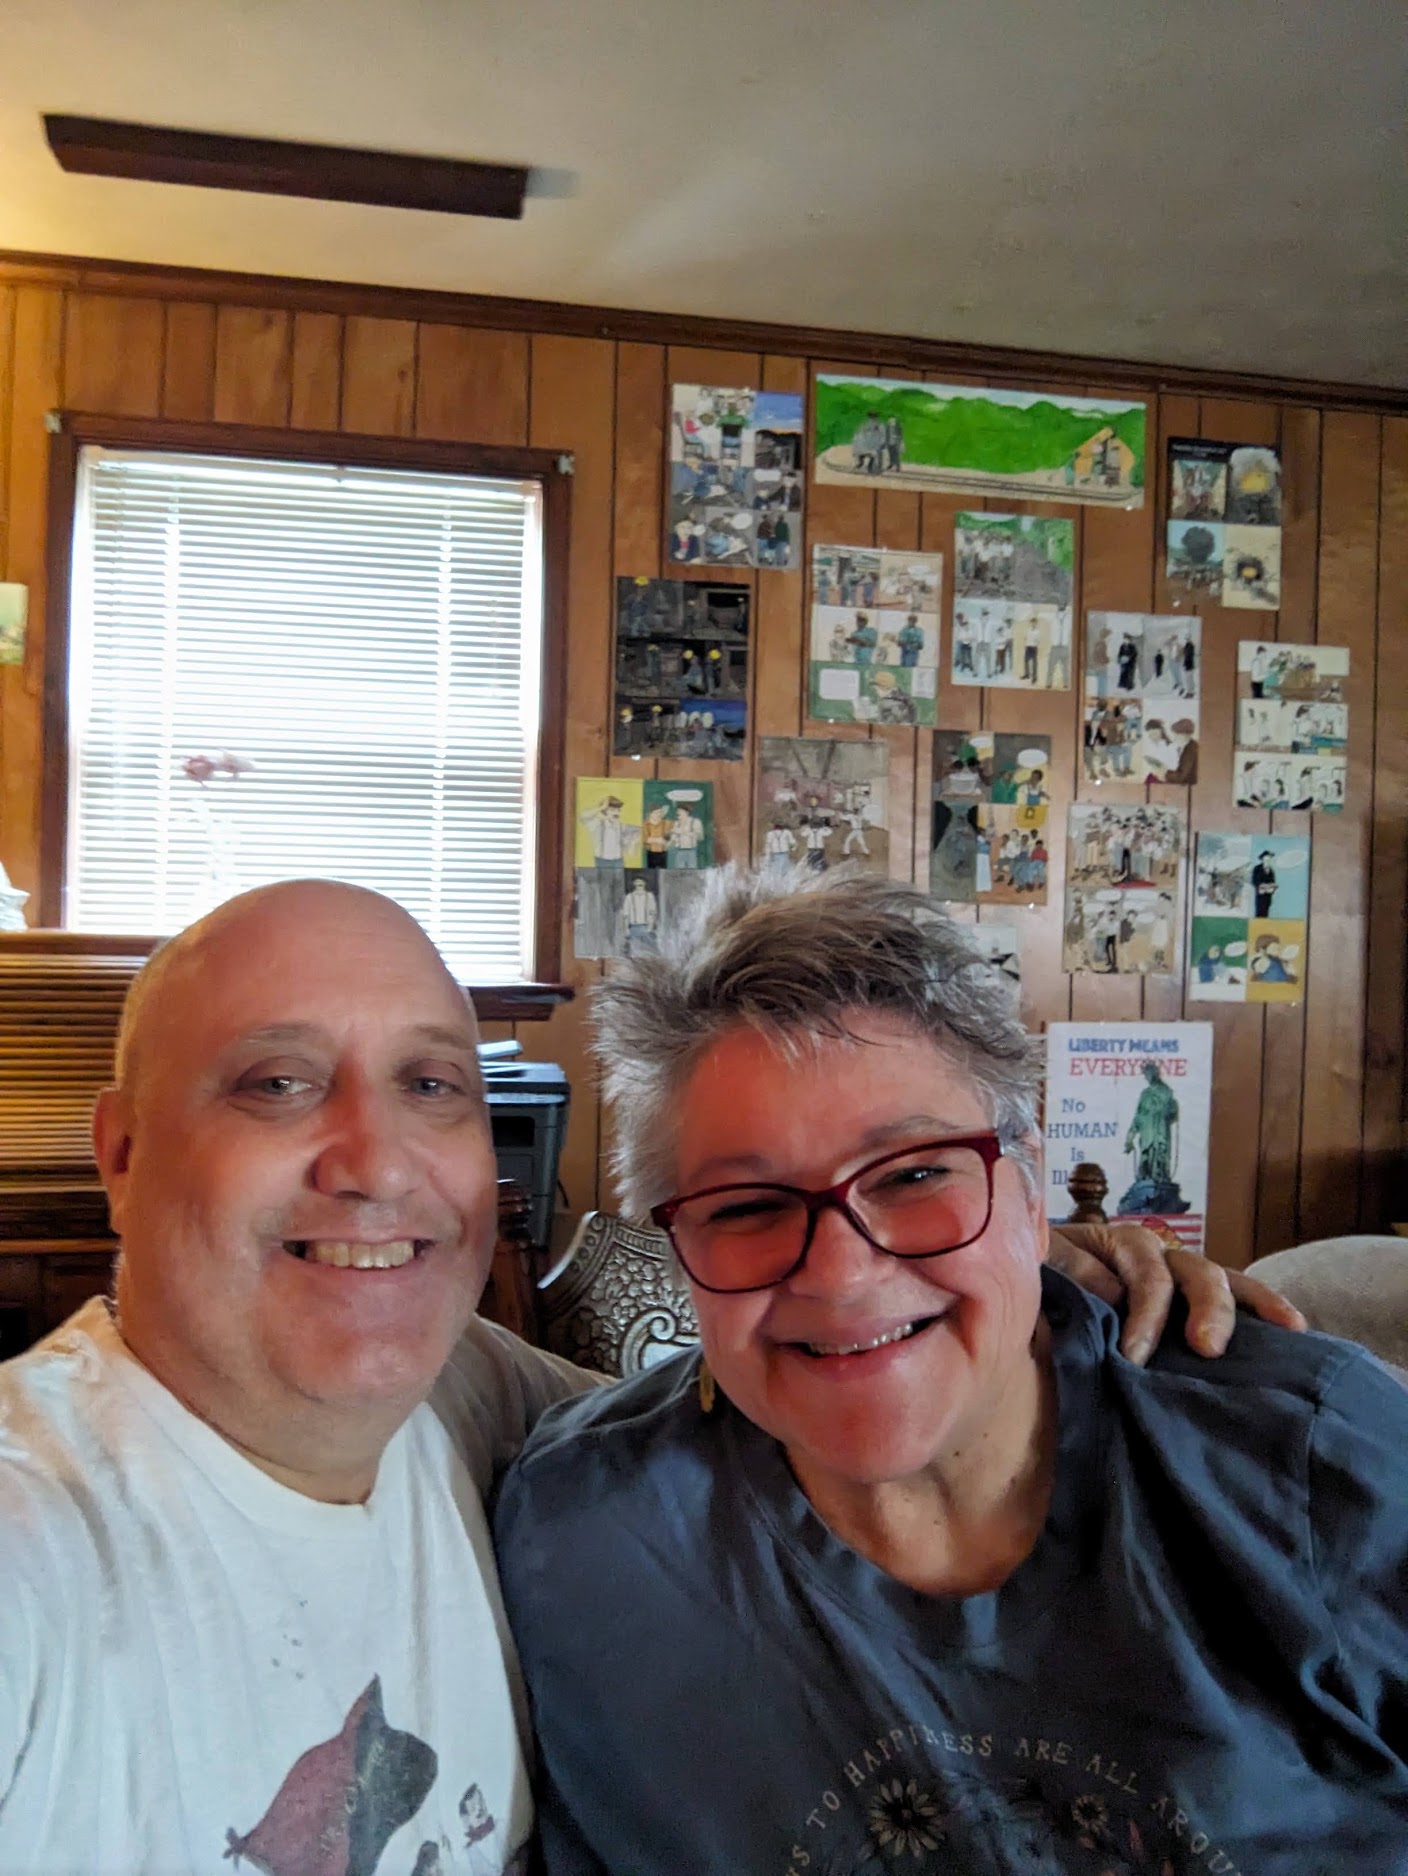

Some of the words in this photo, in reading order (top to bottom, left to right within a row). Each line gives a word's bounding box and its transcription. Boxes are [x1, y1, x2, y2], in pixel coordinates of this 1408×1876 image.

[1068, 1038, 1126, 1053] LIBERTY
[1062, 1098, 1086, 1113] No
[1047, 1121, 1118, 1139] HUMAN
[1070, 1147, 1085, 1162] Is
[805, 1790, 841, 1830] TO
[1014, 1737, 1072, 1766] ARE
[1085, 1754, 1139, 1794] ALL
[1149, 1796, 1242, 1876] AROU
